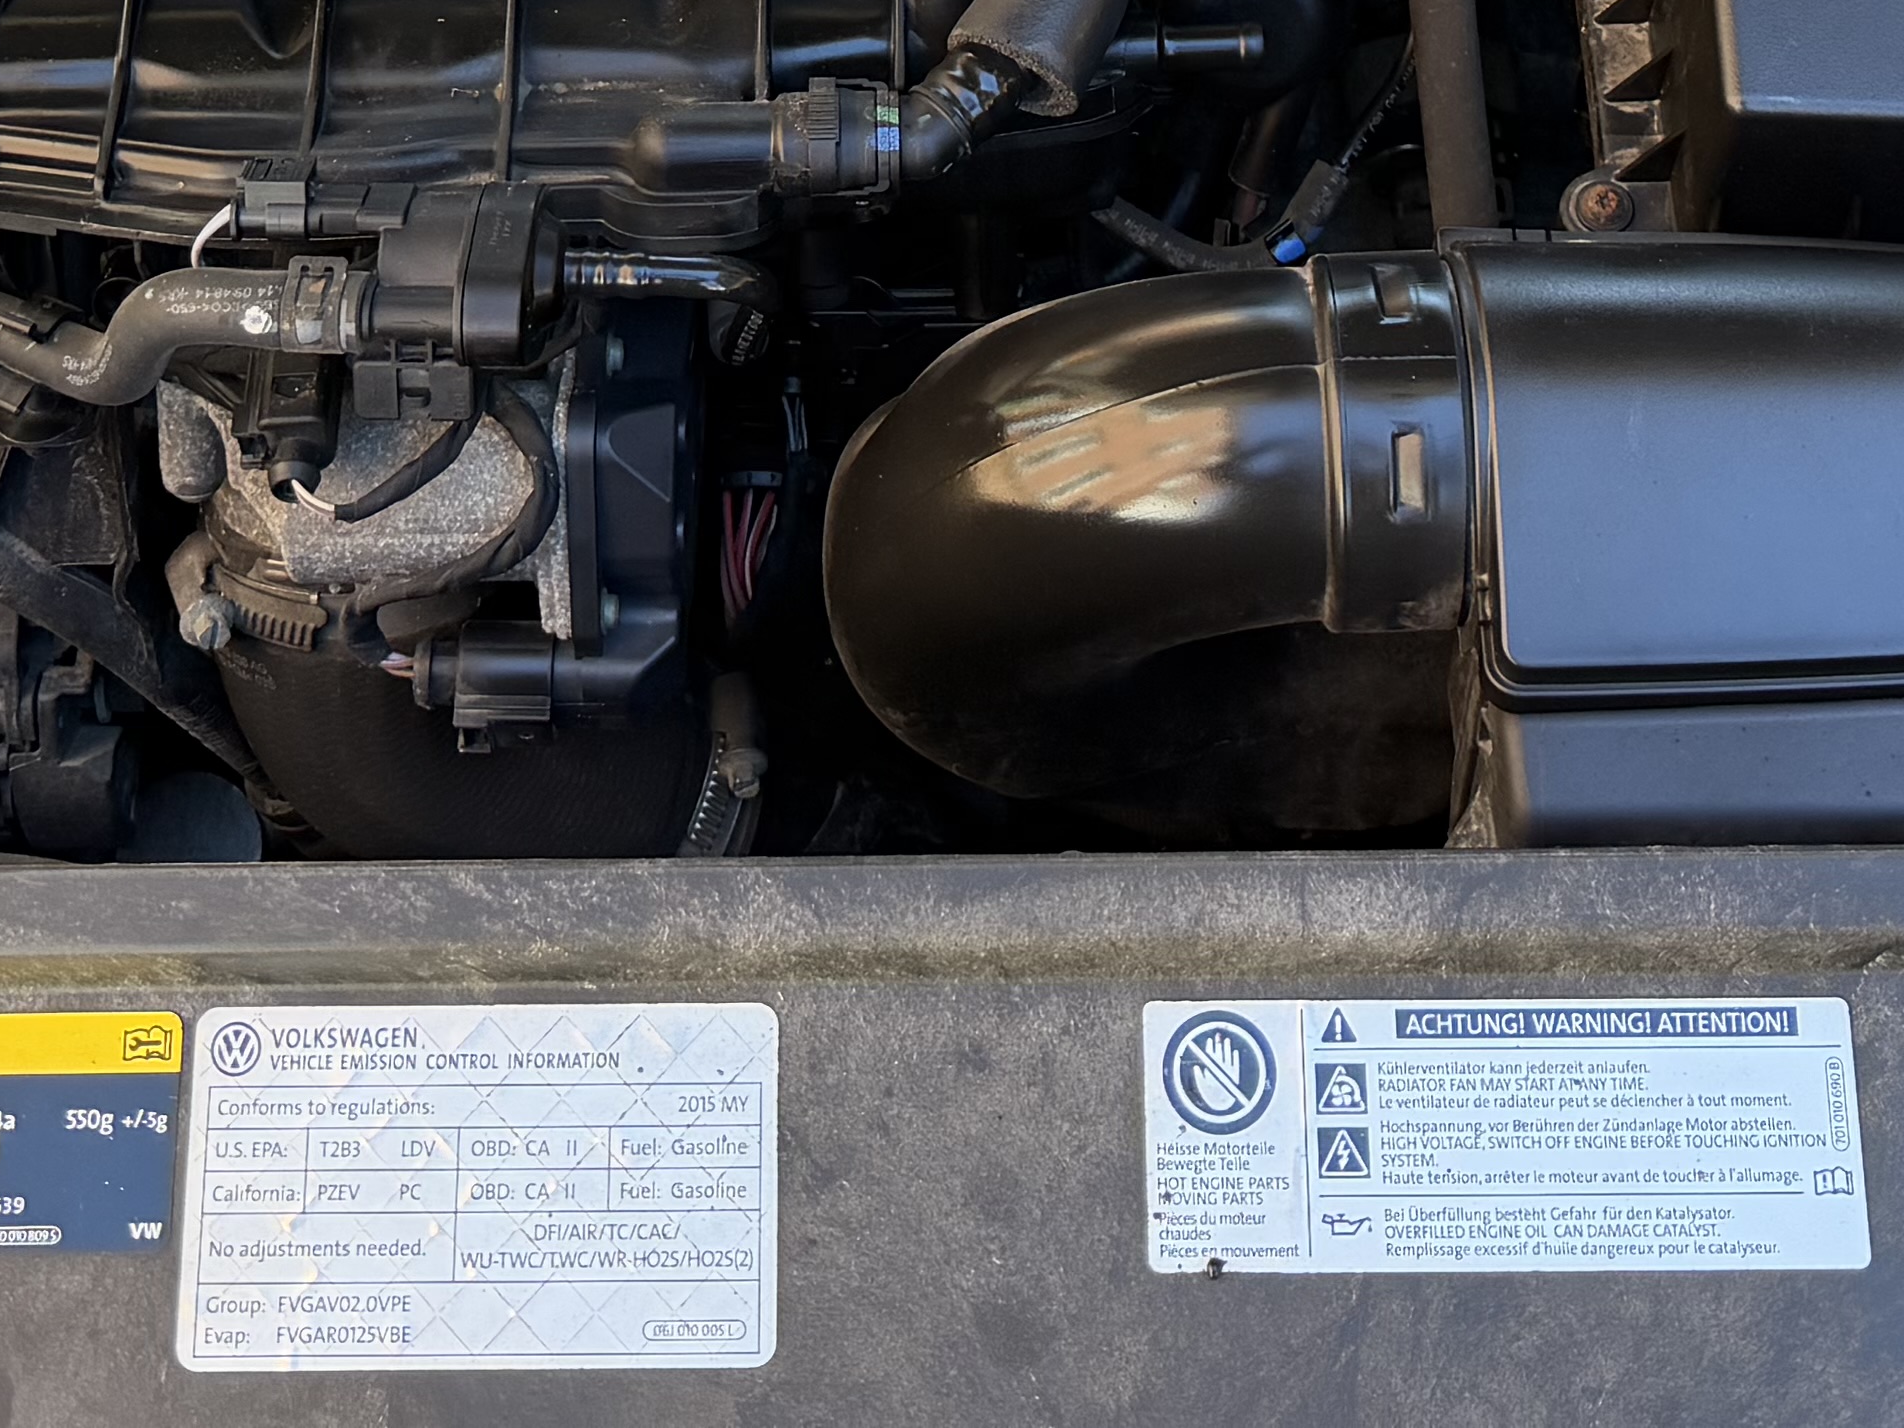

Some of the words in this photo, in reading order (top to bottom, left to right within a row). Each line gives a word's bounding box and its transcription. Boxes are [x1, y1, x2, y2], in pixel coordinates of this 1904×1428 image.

[1405, 1013, 1526, 1035] ACHTUNG!
[1532, 1012, 1652, 1034] WARNING!
[1658, 1010, 1789, 1033] ATTENTION!
[272, 1026, 418, 1049] VOLKSWAGEN
[270, 1054, 333, 1070] VEHICLE
[340, 1053, 417, 1070] EMISSION
[426, 1053, 499, 1070] CONTROL
[507, 1052, 620, 1069] INFORMATION
[1378, 1078, 1446, 1092] RADIATOR
[1449, 1077, 1476, 1092] FAN
[1480, 1077, 1511, 1092] MAY
[1514, 1077, 1555, 1092] START
[1610, 1076, 1648, 1091] TIME.
[218, 1098, 302, 1116] Conforms
[308, 1099, 327, 1116] to
[330, 1098, 435, 1121] regulations:
[678, 1096, 716, 1113] 2015
[721, 1095, 749, 1112] MY
[65, 1109, 114, 1135] 550g
[121, 1109, 168, 1134] +/-5g
[215, 1142, 247, 1157] U.S.
[252, 1142, 288, 1157] EPA:
[319, 1140, 361, 1157] T2B3
[401, 1140, 436, 1157] LDV
[471, 1140, 517, 1156] OBD:
[525, 1140, 550, 1156] CA
[566, 1139, 577, 1156] II
[621, 1138, 662, 1156] Fuel:
[671, 1137, 748, 1155] Gasoline
[1158, 1142, 1200, 1156] Heisse
[1204, 1141, 1276, 1156] Motorteile
[1380, 1136, 1417, 1150] HIGH
[1419, 1135, 1485, 1150] VOLTAGE,
[1487, 1135, 1542, 1149] SWITCH
[1544, 1135, 1570, 1150] OFF
[1574, 1134, 1627, 1149] ENGINE
[1630, 1134, 1681, 1149] BEFORE
[1684, 1134, 1760, 1148] TOUCHING
[1763, 1133, 1826, 1148] IGNITION
[1157, 1157, 1215, 1175] Bewegte
[1218, 1157, 1251, 1171] Teile
[1381, 1154, 1439, 1168] SYSTEM.
[212, 1184, 301, 1202] California:
[317, 1184, 360, 1201] PZEV
[399, 1183, 422, 1200] PC
[470, 1183, 516, 1200] OBD:
[524, 1183, 550, 1200] CA
[565, 1182, 575, 1199] II
[620, 1182, 661, 1199] Fuel:
[671, 1181, 747, 1198] Gasoline
[1158, 1176, 1188, 1190] HOT
[1192, 1176, 1245, 1190] ENGINE
[1248, 1176, 1290, 1190] PARTS
[1158, 1192, 1218, 1206] MOVING
[1222, 1192, 1264, 1205] PARTS
[1159, 1212, 1197, 1226] Pièces
[1200, 1212, 1216, 1225] du
[1219, 1213, 1266, 1225] moteur
[129, 1222, 162, 1239] VW
[534, 1223, 681, 1241] DFI/AIR/TC/CAC/
[1159, 1227, 1211, 1241] chaudes
[1384, 1224, 1465, 1239] OVERFILLED
[1468, 1224, 1521, 1239] ENGINE
[1524, 1224, 1547, 1239] OIL
[1553, 1224, 1583, 1238] CAN
[1586, 1223, 1649, 1238] DAMAGE
[1652, 1223, 1721, 1237] CATALYST.
[209, 1241, 234, 1257] No
[239, 1240, 350, 1262] adjustments
[356, 1239, 426, 1257] needed.
[1160, 1244, 1198, 1258] Pièces
[1201, 1247, 1218, 1258] en
[1221, 1245, 1300, 1258] mouvement
[206, 1296, 267, 1318] Group:
[204, 1327, 250, 1349] Evap:
